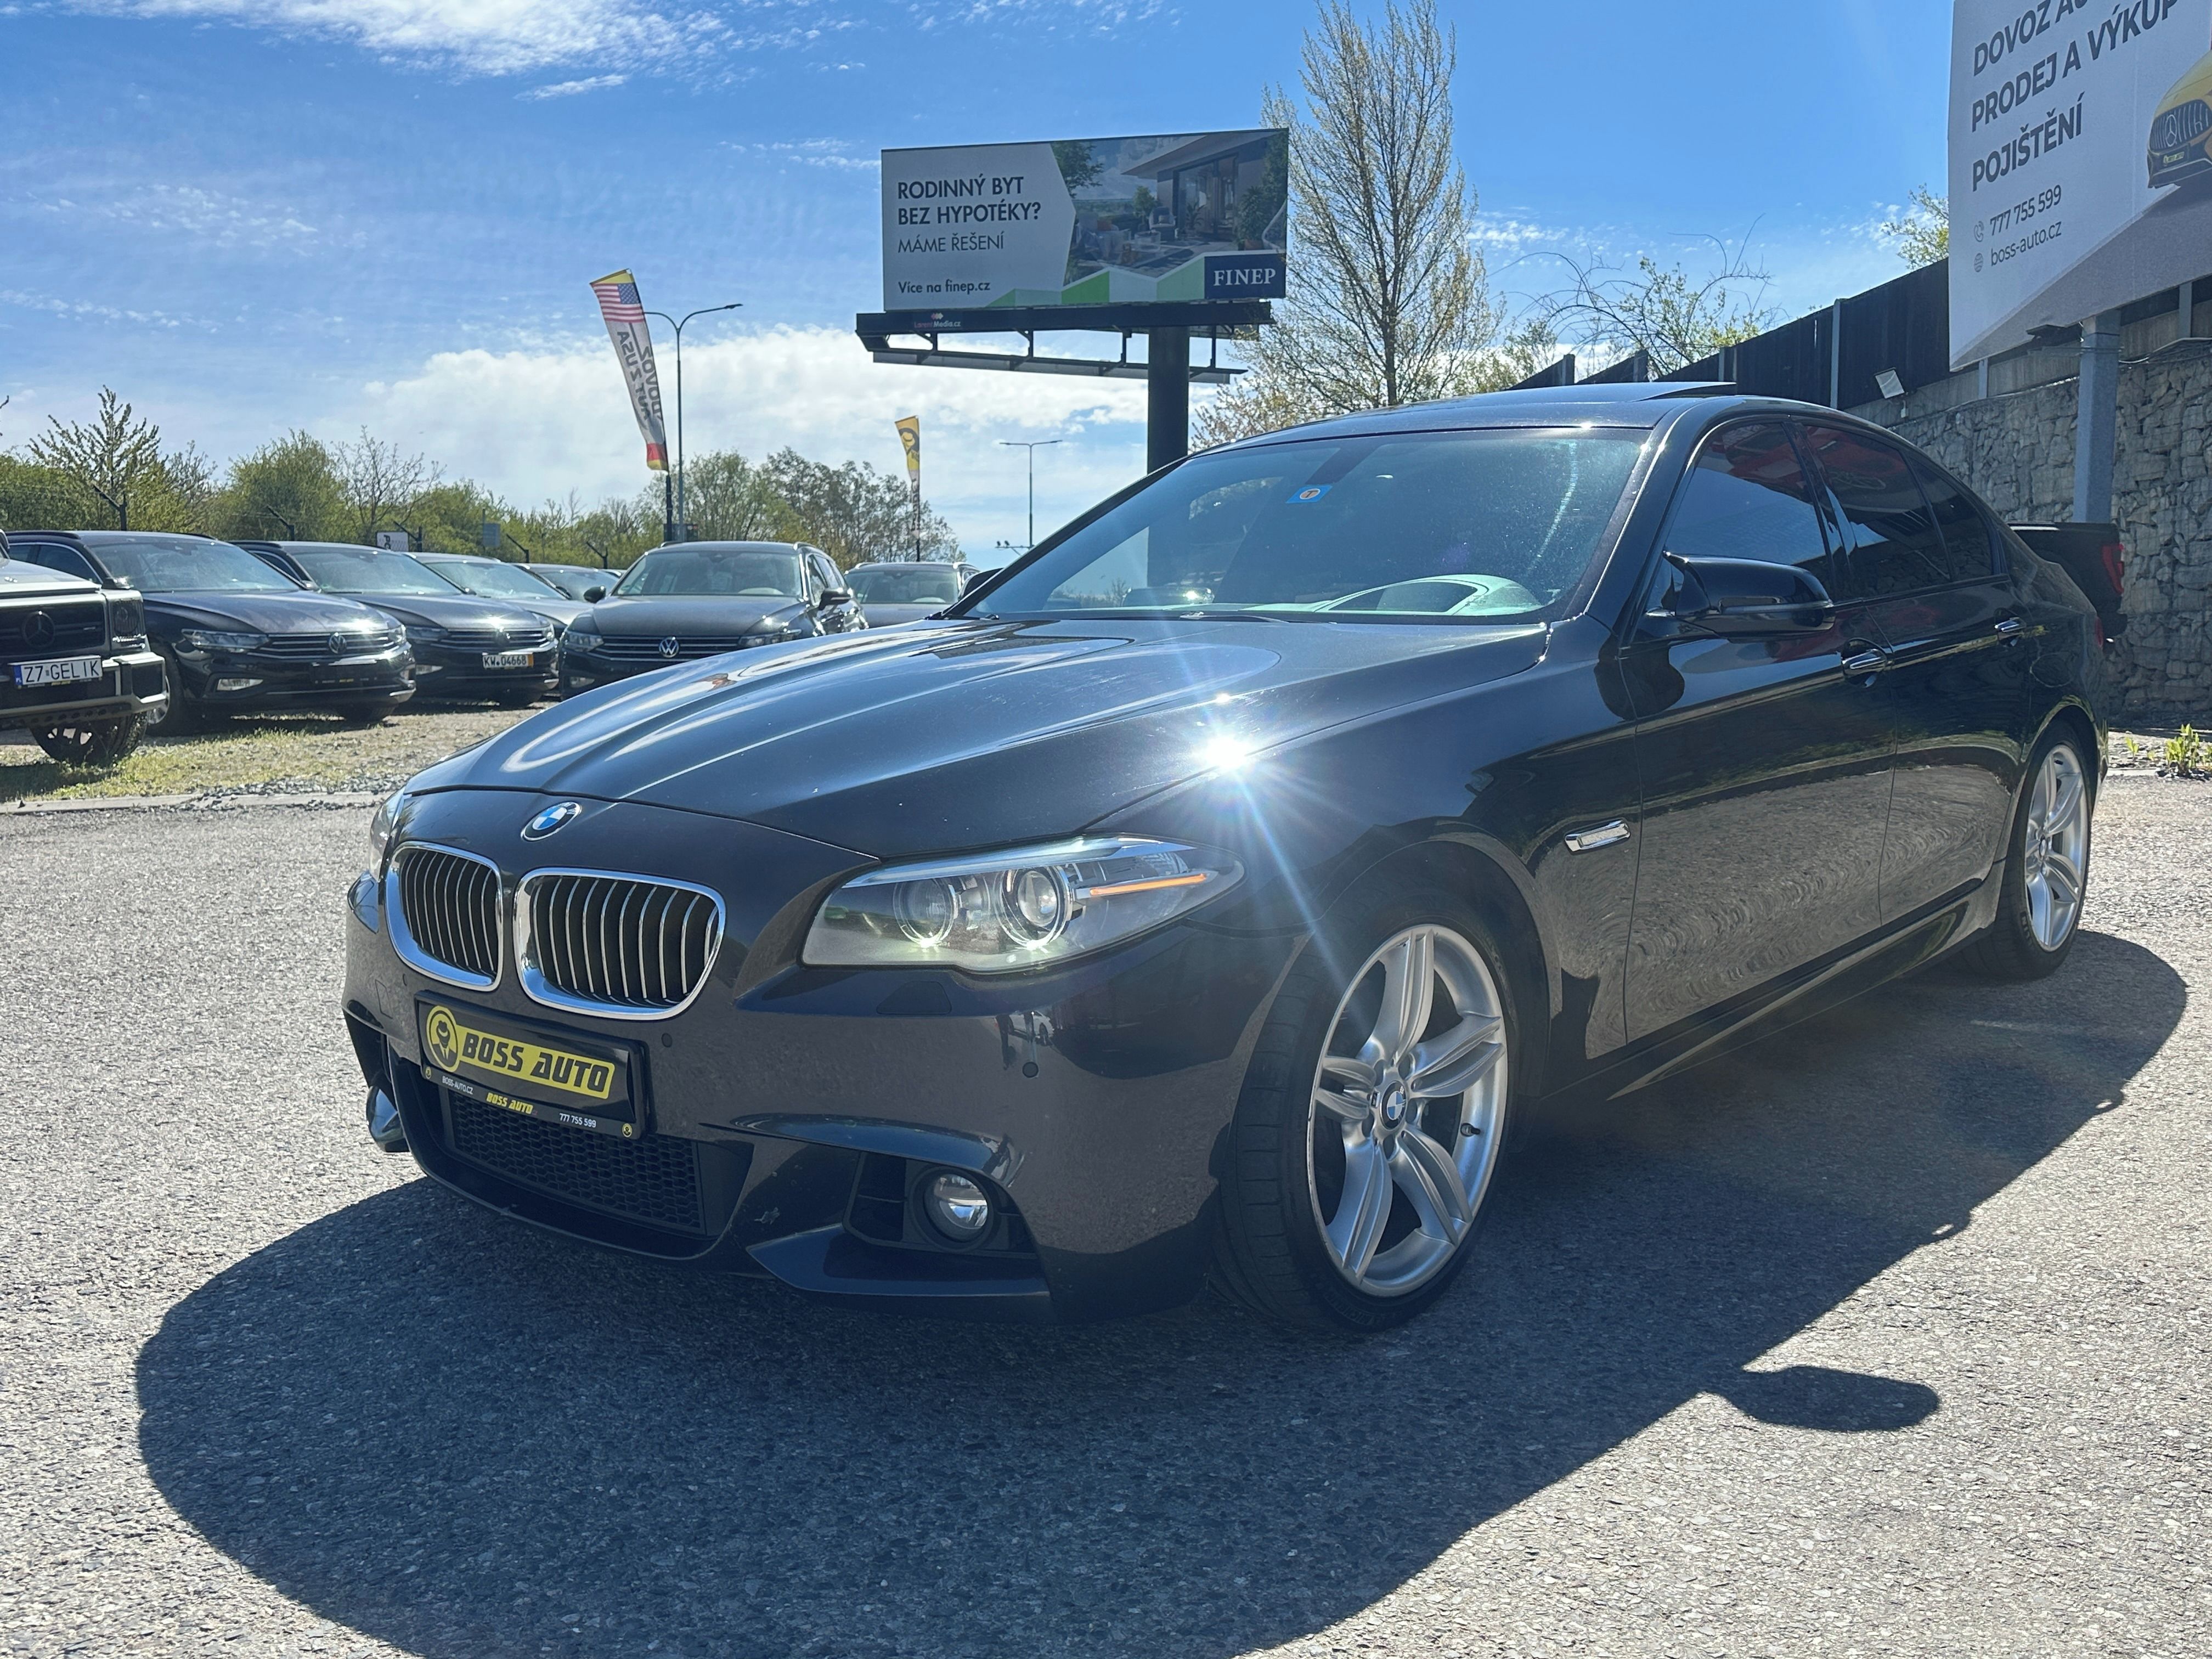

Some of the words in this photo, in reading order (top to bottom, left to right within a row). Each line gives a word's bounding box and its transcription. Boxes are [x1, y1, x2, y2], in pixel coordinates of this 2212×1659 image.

[1973, 0, 2051, 76] DOVOZ
[1972, 52, 2057, 132] PRODEJ
[2062, 40, 2081, 78] A
[1972, 91, 2085, 191] POJIŠTĚNÍ
[898, 173, 985, 199] RODINNÝ
[992, 177, 1024, 195] BYT
[898, 207, 930, 225] BEZ
[938, 199, 1041, 224] HYPOTÉKY?
[1990, 209, 2011, 235] 777
[2014, 197, 2035, 224] 755
[2038, 184, 2061, 212] 599
[898, 234, 946, 253] MÁME
[951, 231, 1005, 251] ŘEŠENÍ
[1991, 221, 2062, 266] boss-auto.cz
[898, 281, 923, 293] Více
[927, 284, 942, 293] na
[945, 279, 991, 295] finep.cz
[1213, 268, 1276, 286] FINEP
[24, 665, 43, 682] Z7
[462, 1032, 524, 1073] BOSS
[530, 1051, 610, 1092] AUTO
[442, 1075, 473, 1095] BOSS-AUTO.CZ
[486, 1092, 508, 1107] BOSS
[509, 1099, 534, 1114] AUTO
[559, 1113, 570, 1121] 777
[571, 1115, 583, 1125] 755
[584, 1118, 596, 1128] 599
